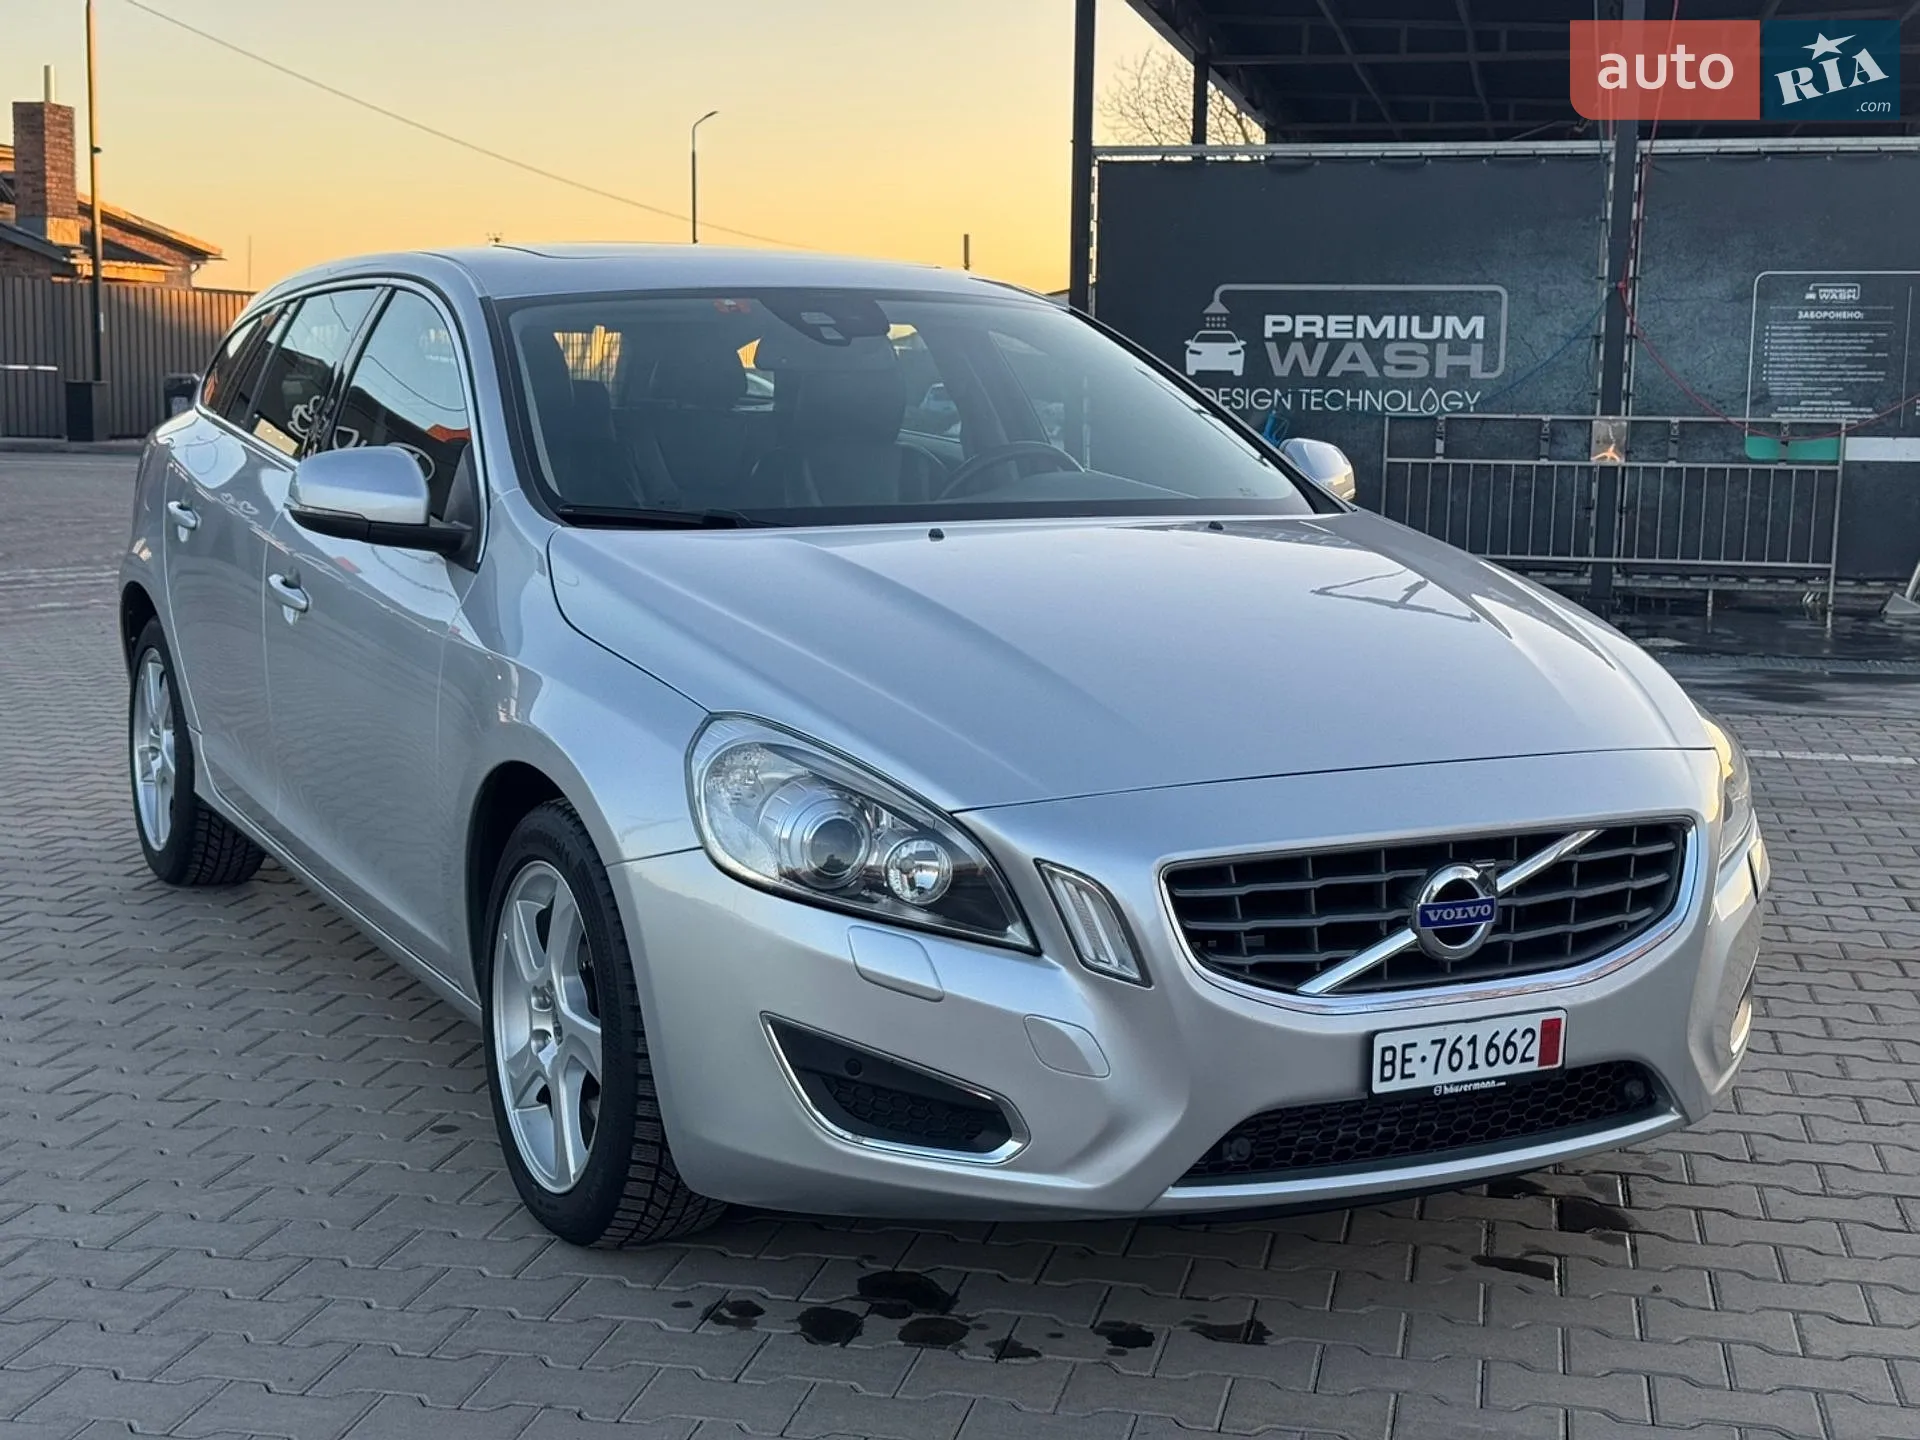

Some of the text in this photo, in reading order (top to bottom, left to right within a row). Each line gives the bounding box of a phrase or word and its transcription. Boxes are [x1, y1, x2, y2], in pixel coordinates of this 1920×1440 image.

[1264, 314, 1485, 340] PREMIUM
[1264, 341, 1492, 379] WASH
[1425, 903, 1492, 922] VOLVO
